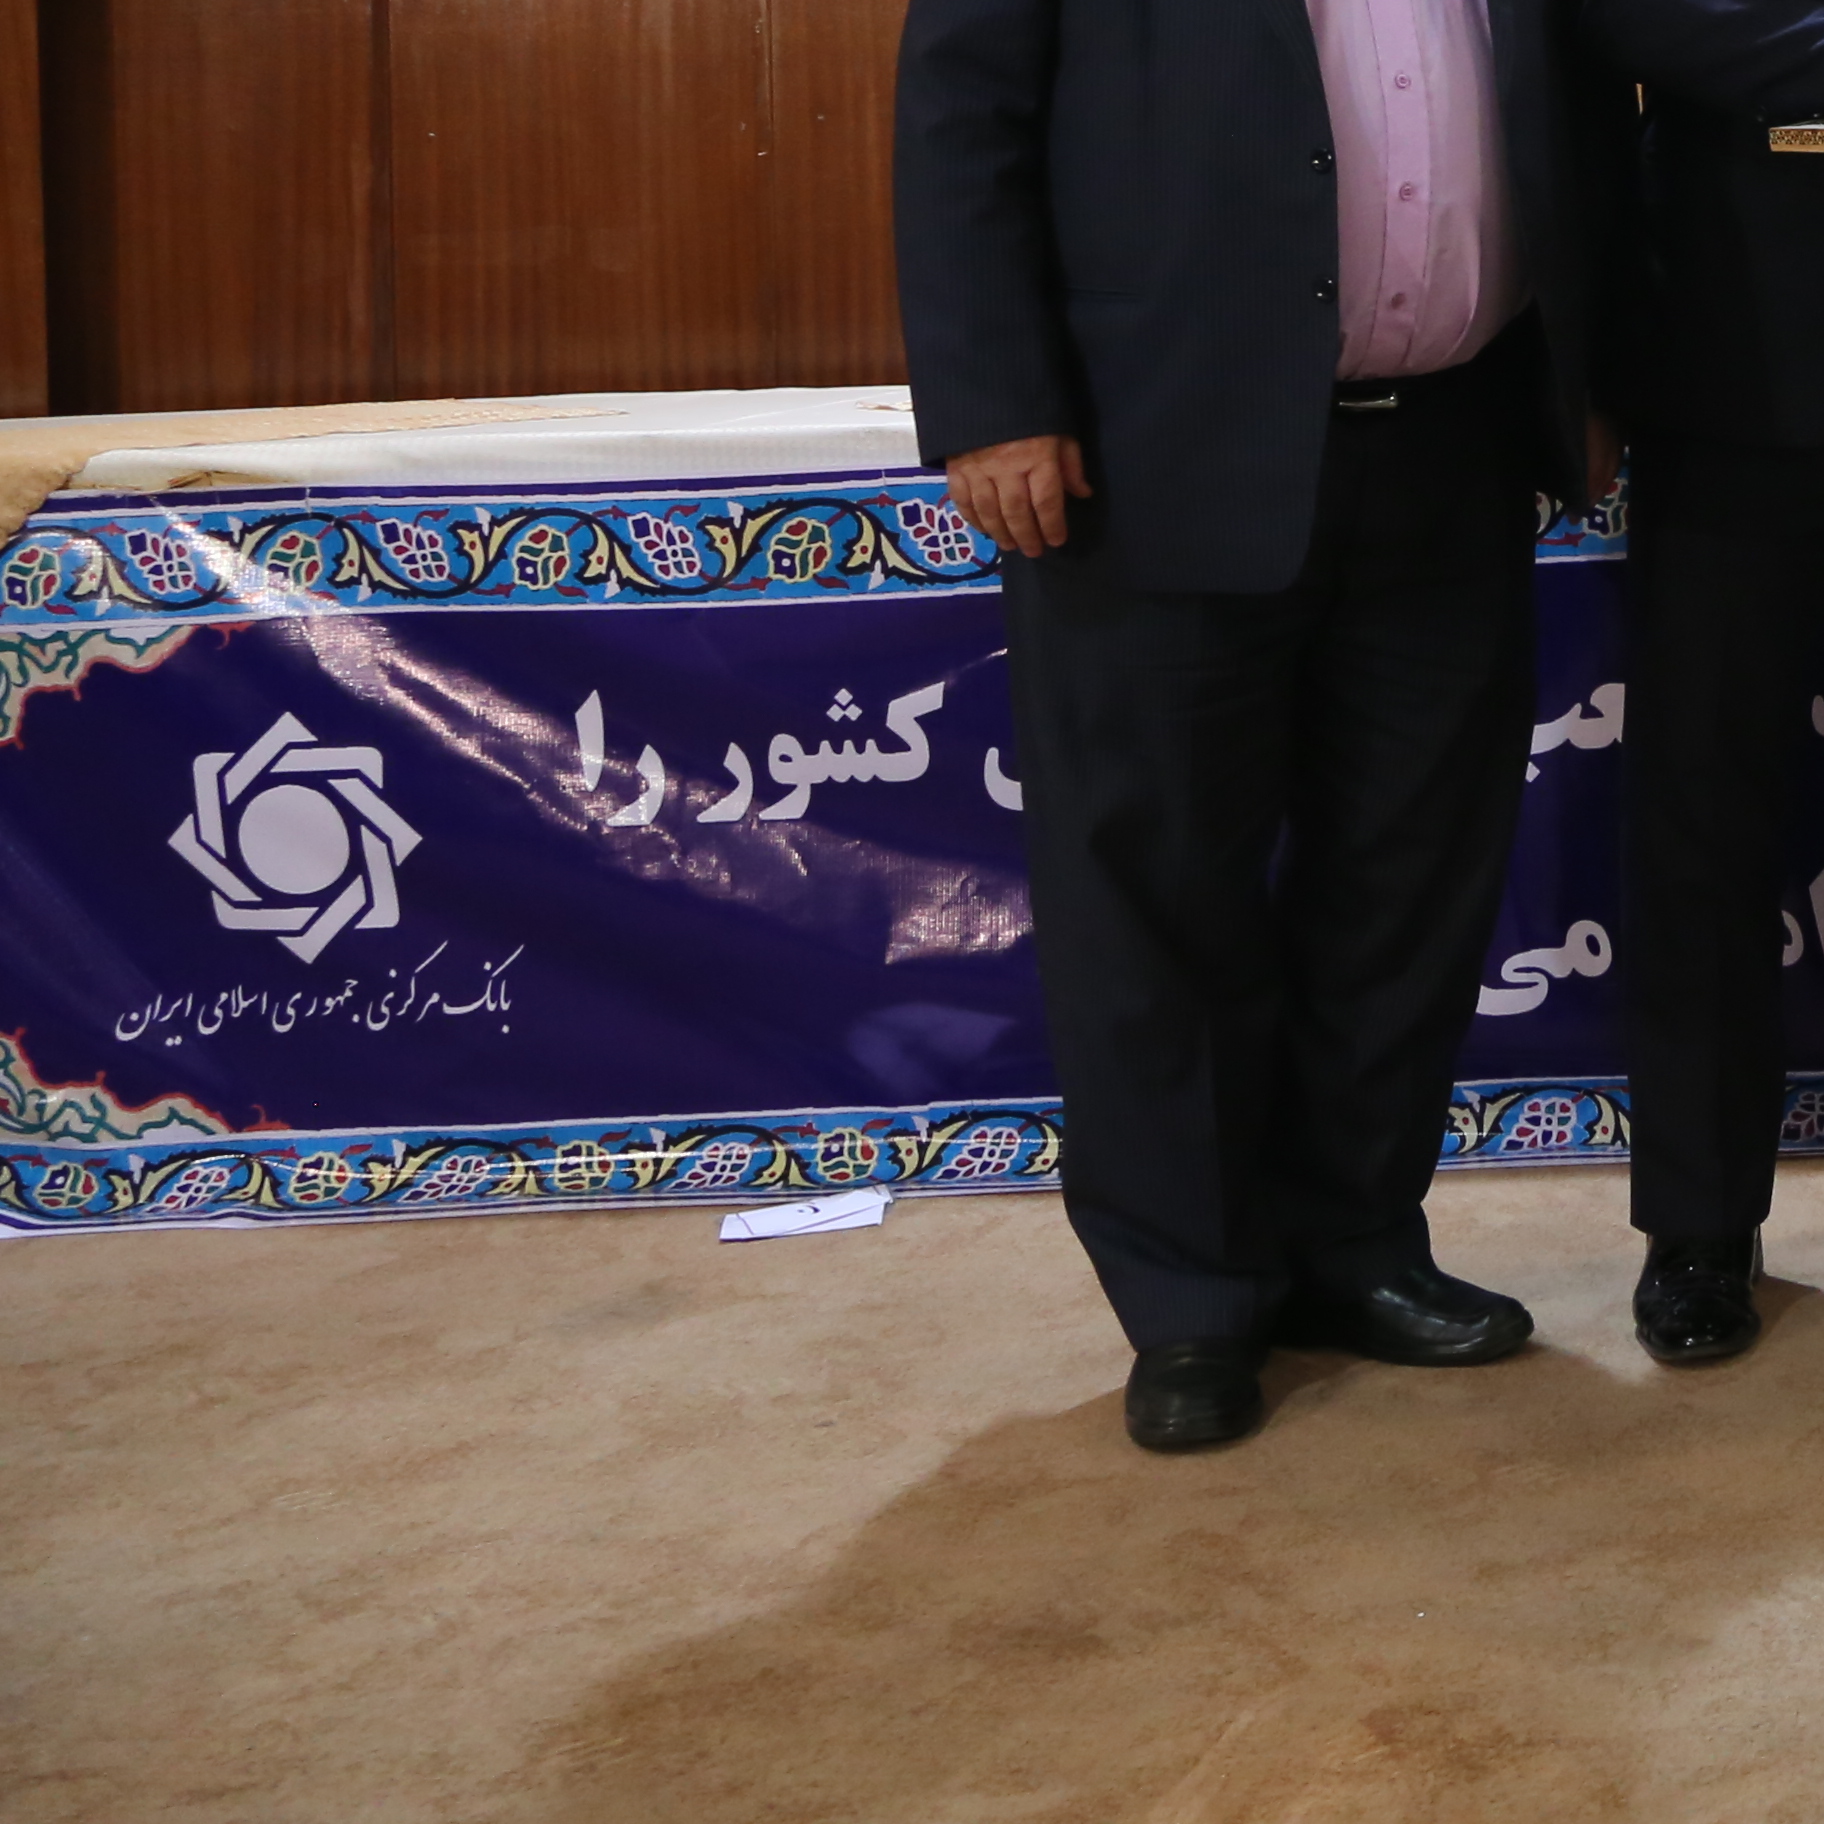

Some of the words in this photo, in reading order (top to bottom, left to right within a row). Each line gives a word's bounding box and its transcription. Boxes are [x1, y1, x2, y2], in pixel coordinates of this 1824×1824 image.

[575, 689, 665, 827] را
[696, 682, 945, 822] کشور
[115, 991, 193, 1047] ایران
[198, 984, 268, 1035] اسلامی
[272, 979, 360, 1033] جمهوری
[367, 940, 448, 1031] مرکزی
[443, 944, 524, 1034] بانک
